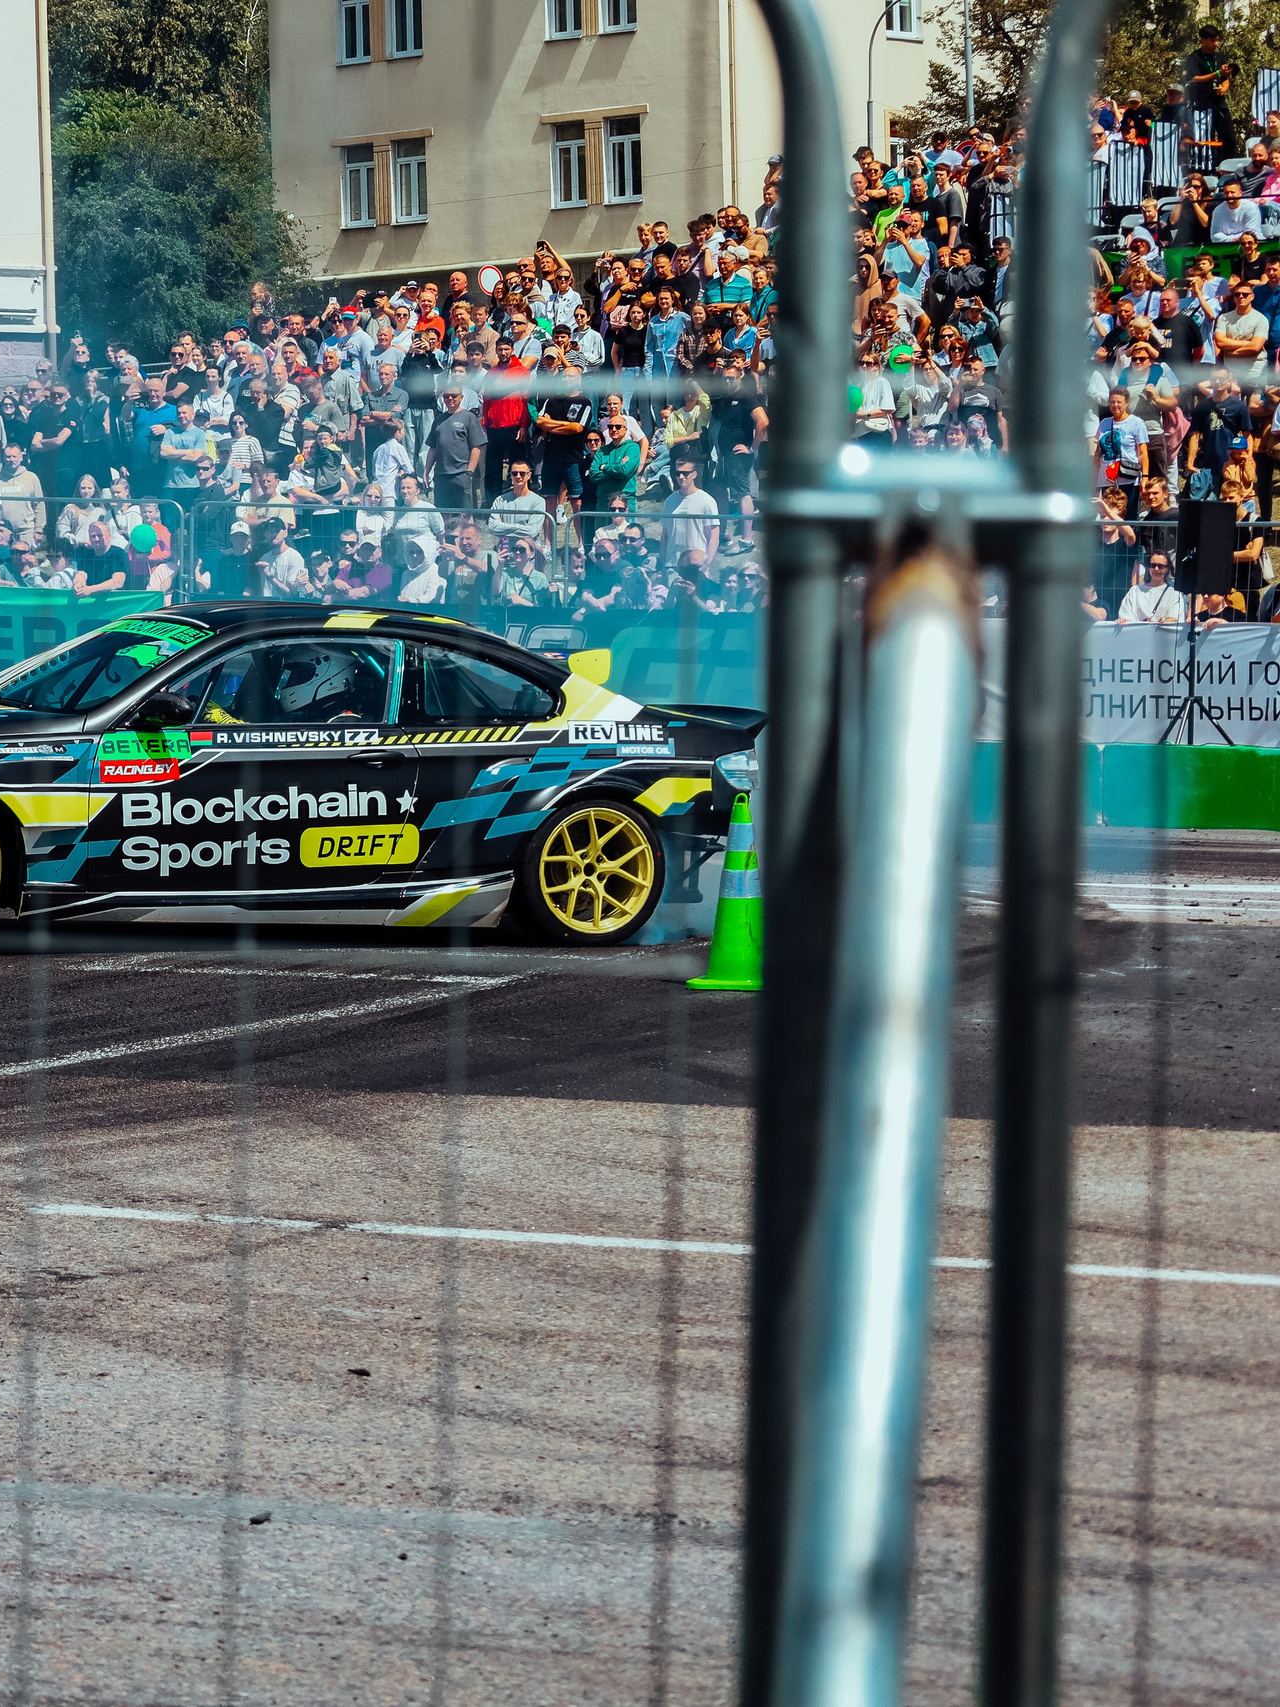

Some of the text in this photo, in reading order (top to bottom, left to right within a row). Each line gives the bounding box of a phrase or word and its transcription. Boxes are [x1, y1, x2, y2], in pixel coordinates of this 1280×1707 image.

[621, 746, 671, 755] MOTOR OIL
[104, 763, 173, 776] RACING.BY
[122, 783, 388, 827] Blockchain
[122, 831, 404, 877] Sports DRIFT
